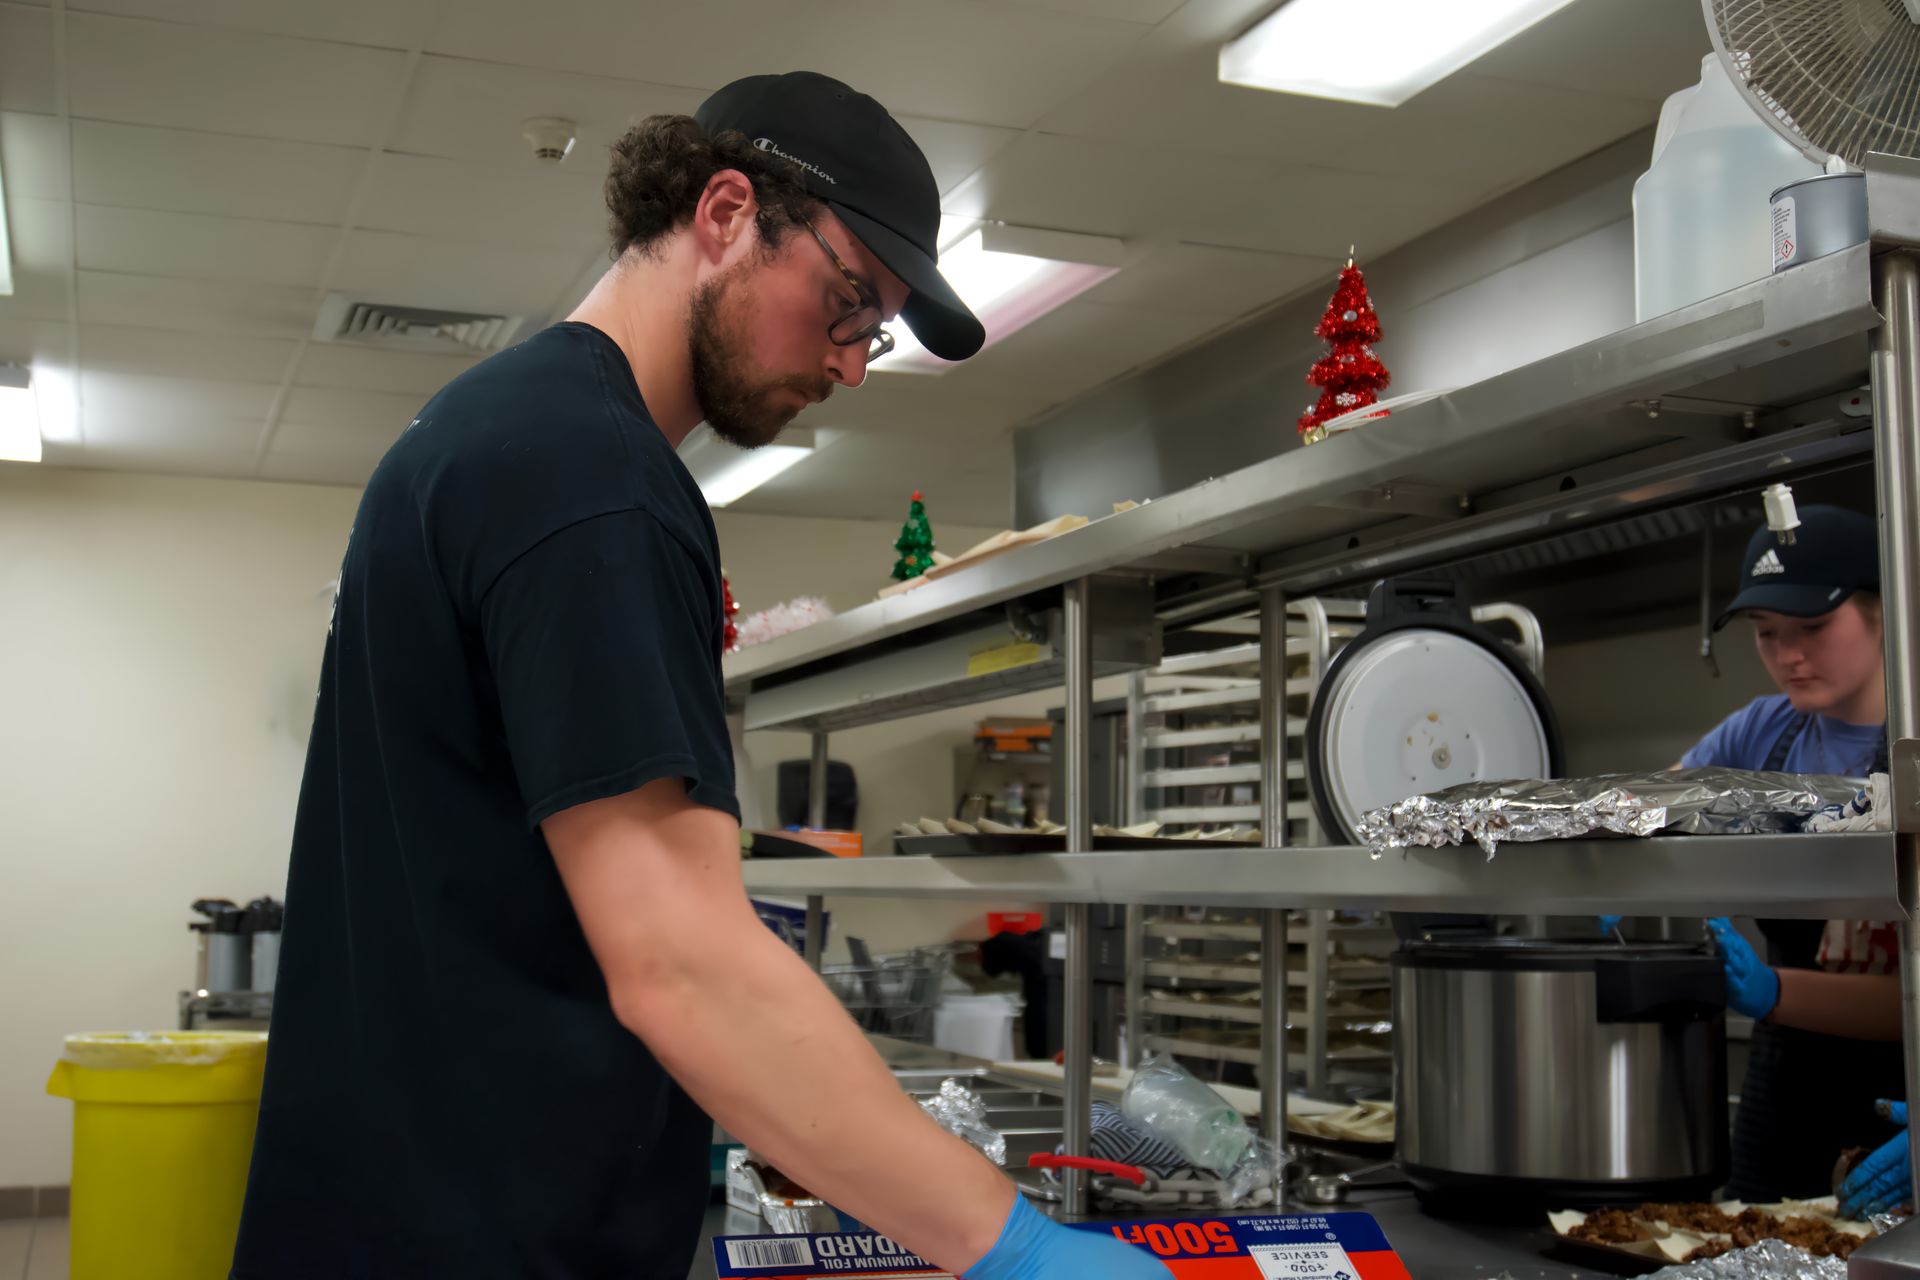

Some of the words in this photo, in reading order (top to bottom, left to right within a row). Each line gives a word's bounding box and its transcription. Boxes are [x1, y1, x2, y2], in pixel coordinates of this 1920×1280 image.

[753, 138, 837, 184] Champion
[1751, 564, 1785, 577] adidas
[815, 1235, 907, 1257] DARD
[1271, 1251, 1329, 1260] SERVICE
[819, 1259, 852, 1270] FOIL
[1290, 1263, 1325, 1273] FOOD
